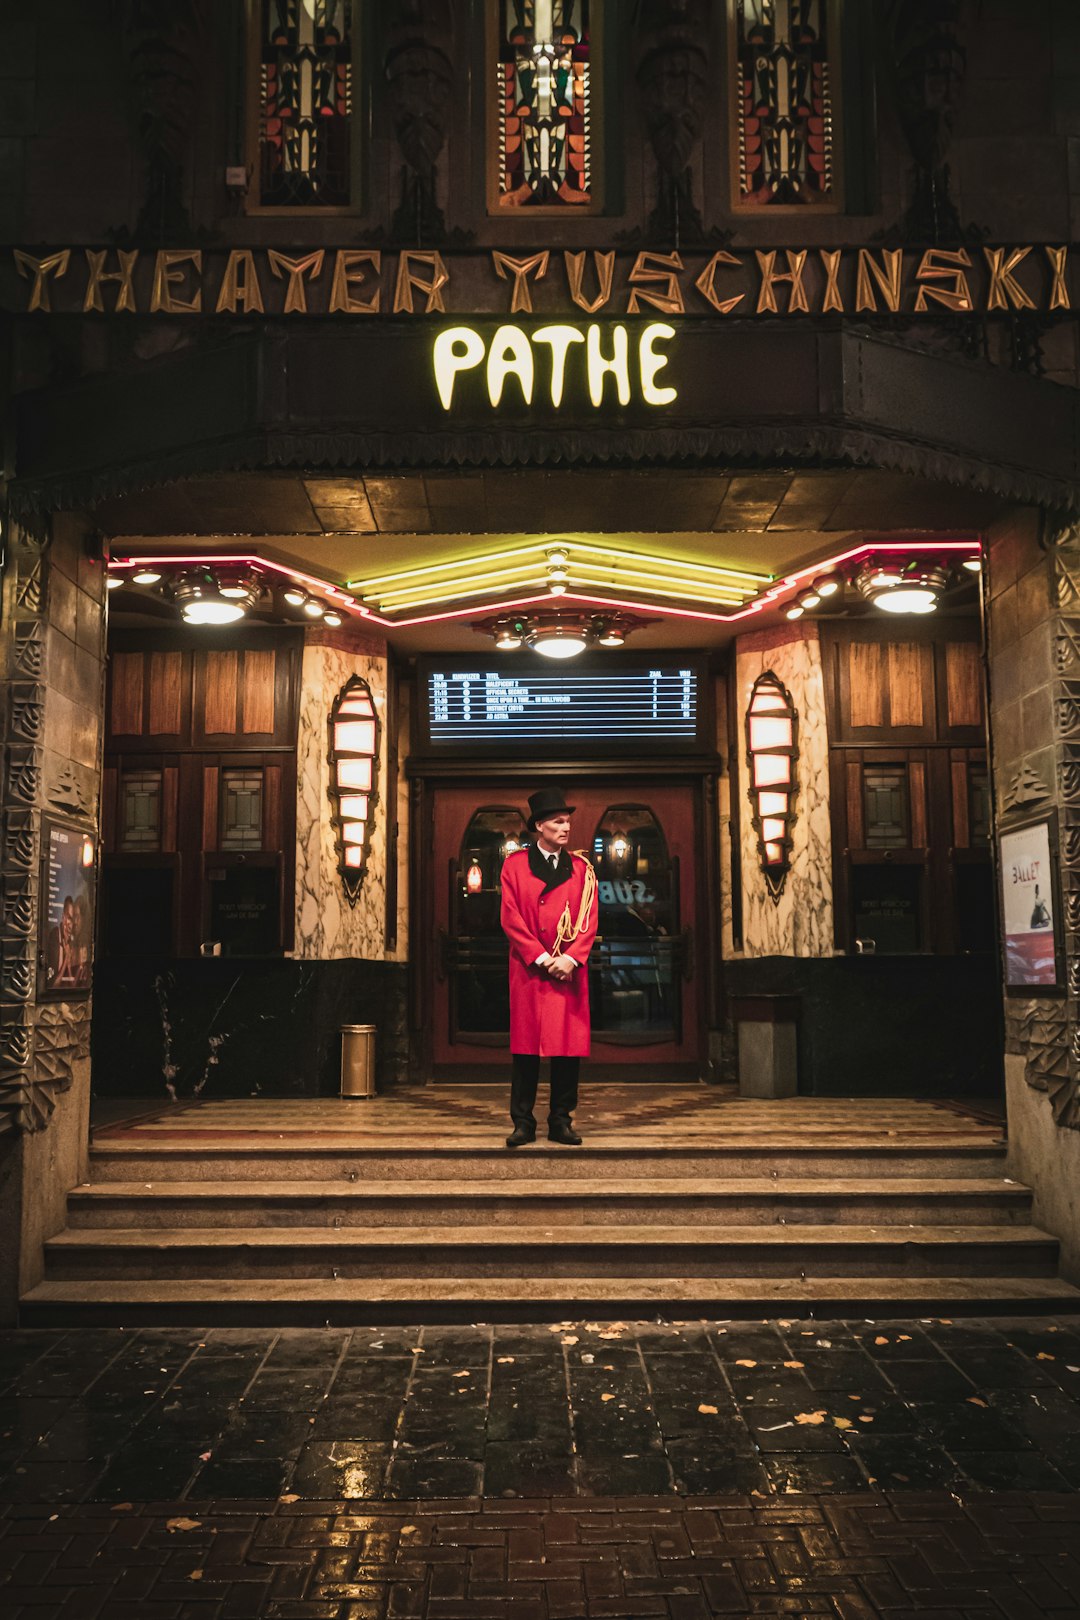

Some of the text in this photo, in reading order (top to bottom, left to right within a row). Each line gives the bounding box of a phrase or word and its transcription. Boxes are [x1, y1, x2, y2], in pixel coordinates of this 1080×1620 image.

[13, 246, 1068, 314] THEATER TUSCHINSKI
[433, 322, 678, 411] PATHE
[1012, 861, 1041, 884] BALLET
